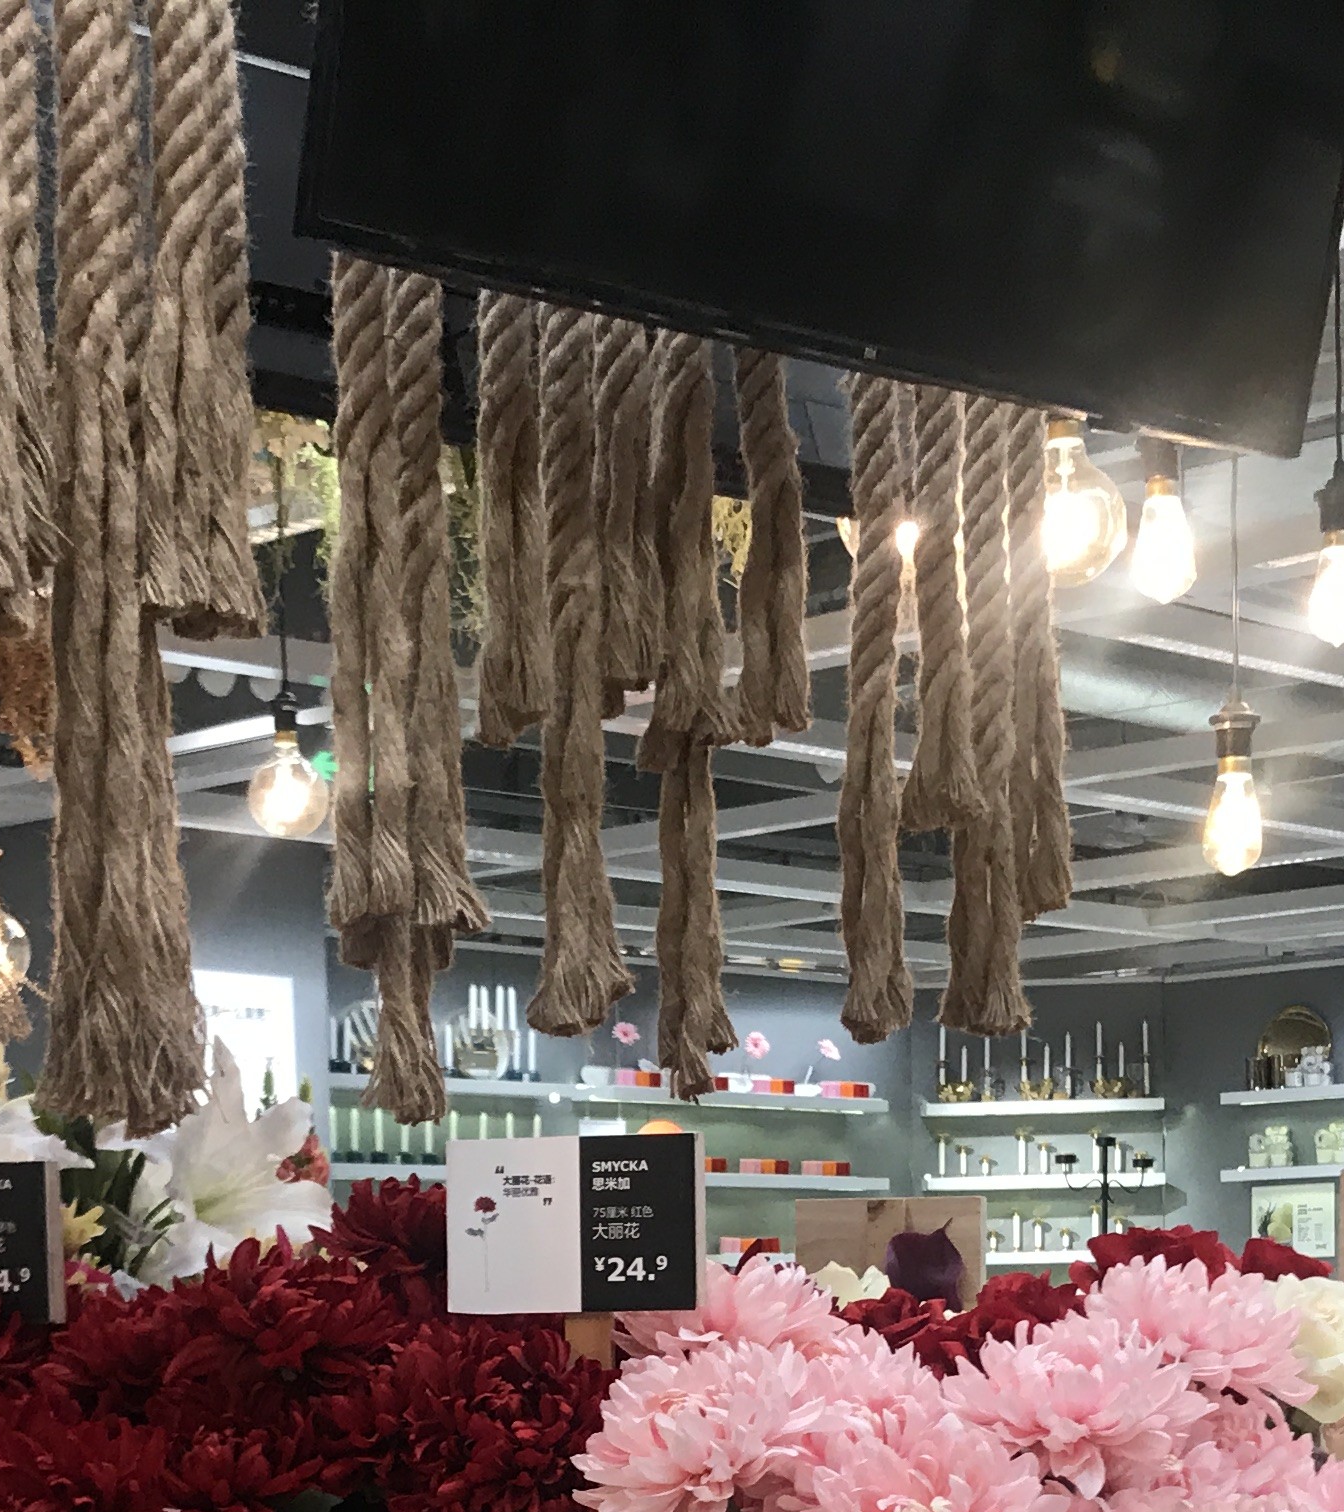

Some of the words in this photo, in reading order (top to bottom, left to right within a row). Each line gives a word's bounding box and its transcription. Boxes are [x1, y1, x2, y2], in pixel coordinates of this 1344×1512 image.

[591, 1159, 649, 1173] SMYCKA
[591, 1177, 631, 1191] 思米加
[592, 1206, 628, 1218] 75厘米
[630, 1205, 654, 1218] 红色
[592, 1222, 640, 1240] 大丽花
[594, 1255, 668, 1283] ¥24.9
